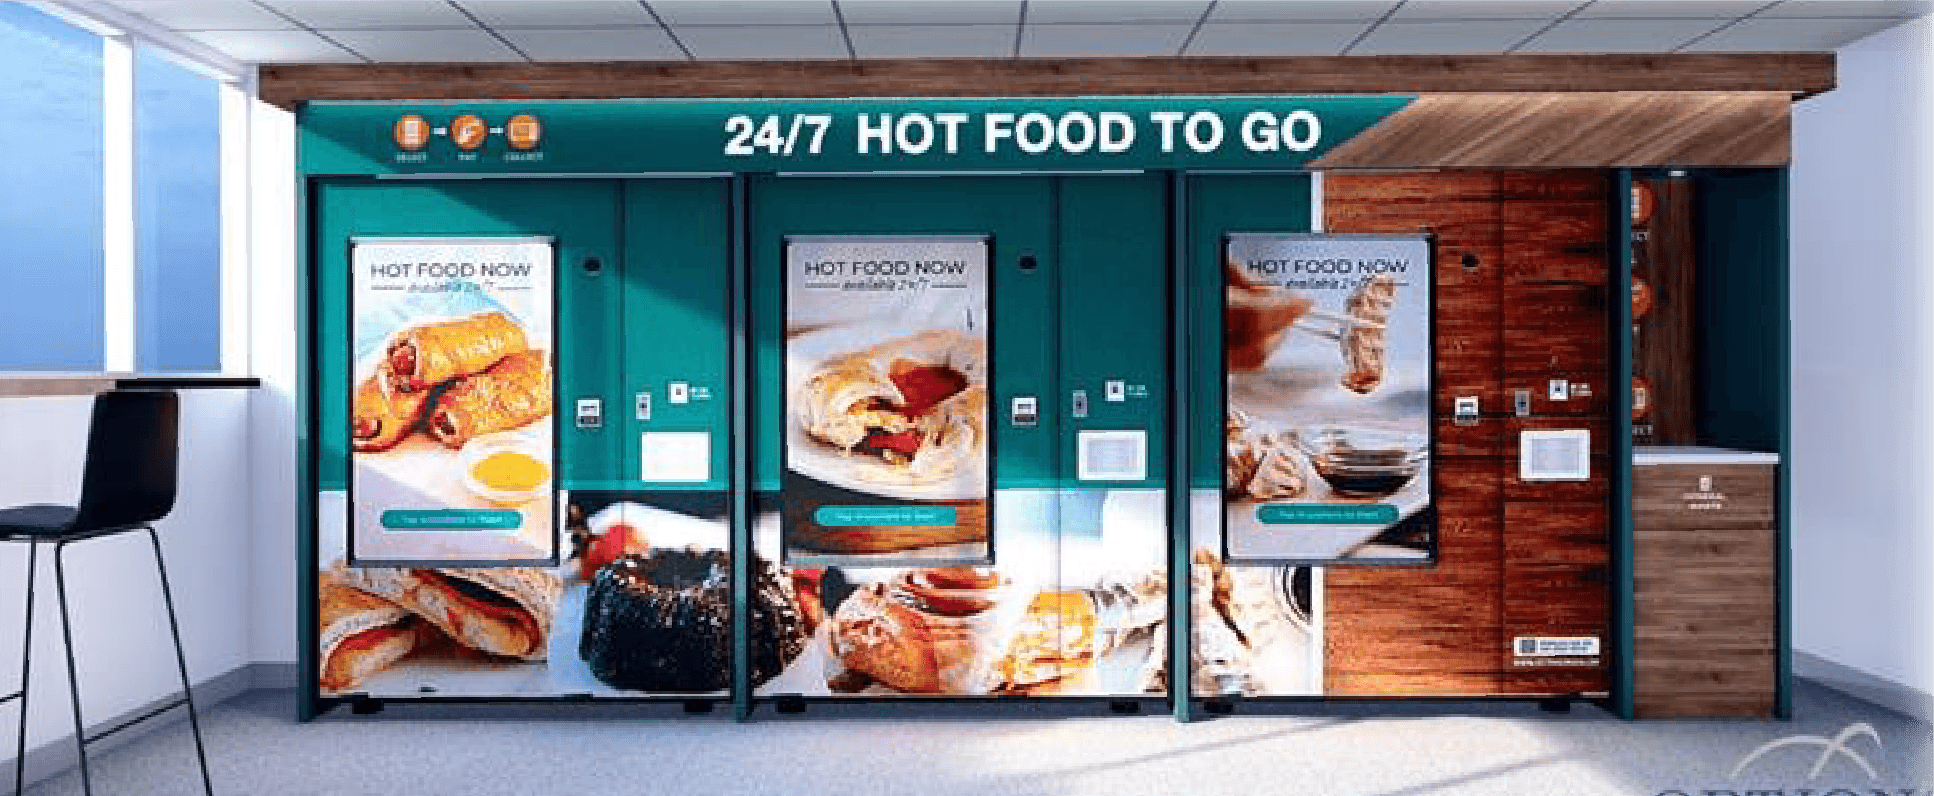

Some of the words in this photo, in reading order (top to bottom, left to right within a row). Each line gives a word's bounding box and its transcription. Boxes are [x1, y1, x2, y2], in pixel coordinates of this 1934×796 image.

[724, 114, 832, 156] 24/7
[857, 113, 969, 154] HOT
[984, 112, 1136, 154] FOOD
[1150, 111, 1224, 152] TO
[1240, 110, 1322, 152] GO
[370, 263, 412, 277] HOT
[416, 263, 475, 277] FOOD
[481, 262, 533, 277] NOW
[804, 261, 845, 275] HOT
[852, 261, 909, 275] FOOD
[916, 260, 966, 274] NOW
[1247, 259, 1290, 273] HOT
[1294, 259, 1352, 273] FOOD
[1358, 259, 1409, 273] NOW
